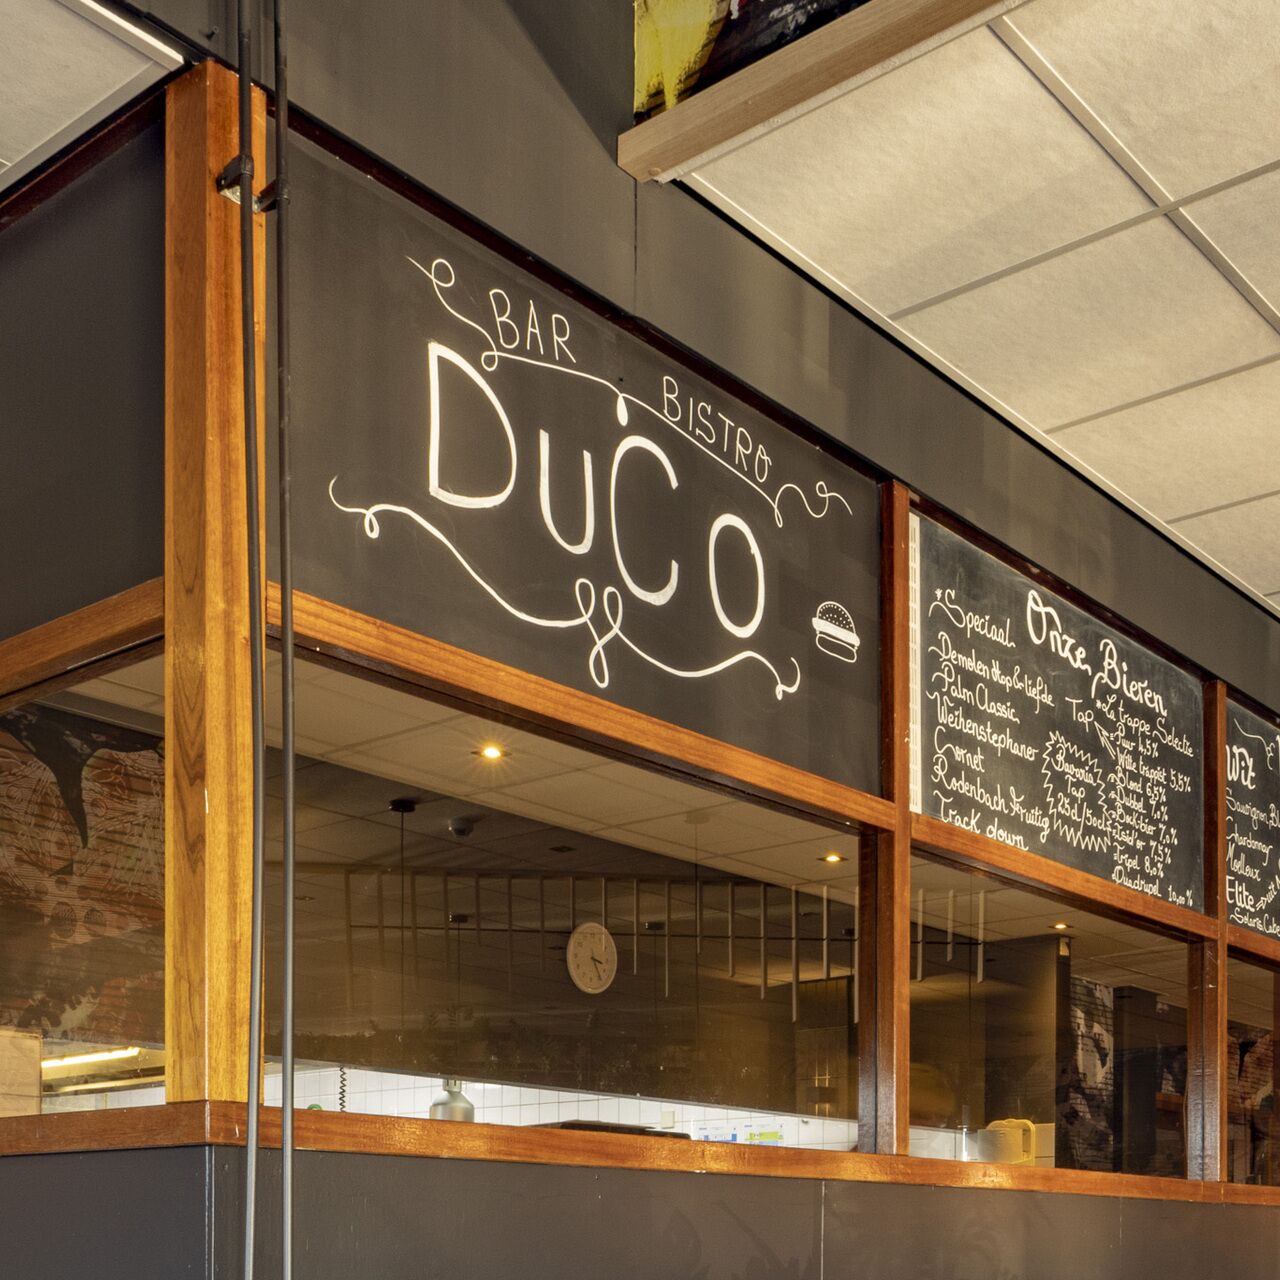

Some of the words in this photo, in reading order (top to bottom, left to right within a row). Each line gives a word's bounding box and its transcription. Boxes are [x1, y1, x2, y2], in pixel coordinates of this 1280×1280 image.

[489, 289, 576, 363] BAR
[661, 375, 773, 484] BISTRO
[1026, 589, 1092, 676] Onze
[1091, 639, 1168, 717] Bieren
[931, 661, 975, 707] Palm
[976, 683, 1020, 724] Classic
[1024, 674, 1055, 714] liefde
[925, 690, 1039, 761] Weihenstephaner
[1065, 697, 1094, 733] Tap
[1118, 700, 1151, 736] trappe
[1152, 717, 1194, 757] Selectie
[934, 726, 985, 773] Cornet
[1051, 743, 1097, 786] Bavaria
[1225, 745, 1256, 790] Wit
[931, 754, 1009, 814] Rodenbach
[1065, 774, 1086, 804] Tap
[1108, 765, 1144, 794] Blond
[1146, 782, 1167, 804] 6,5%
[1109, 785, 1147, 814] Dubbel
[1170, 768, 1192, 793] 5,5%
[986, 817, 1029, 851] down
[1149, 840, 1172, 865] 7,5%
[1159, 822, 1178, 846] 7,0%
[1112, 842, 1141, 872] Tripel
[1144, 856, 1165, 879] 8,0%
[1113, 865, 1163, 898] Quadrupel
[1226, 875, 1255, 912] Elite
